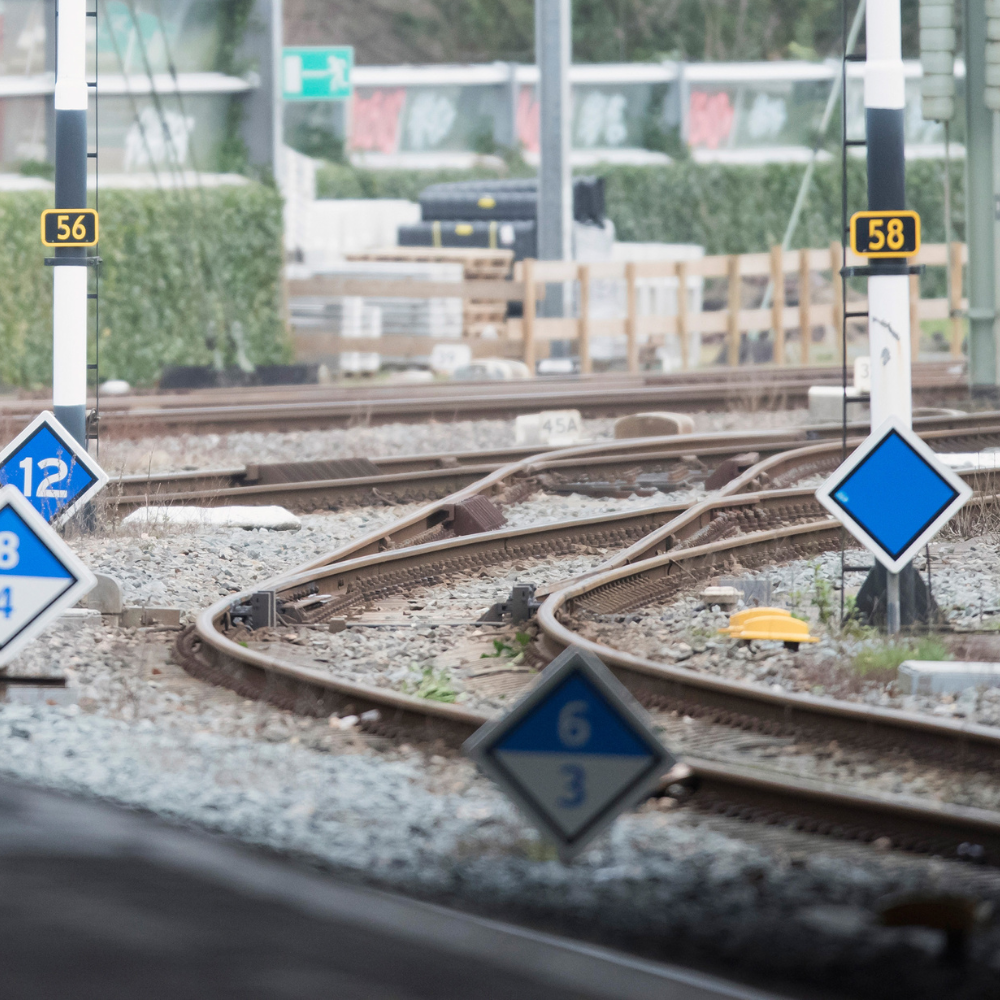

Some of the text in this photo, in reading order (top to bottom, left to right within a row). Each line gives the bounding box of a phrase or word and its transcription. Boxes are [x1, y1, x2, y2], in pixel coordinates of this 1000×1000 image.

[56, 214, 87, 241] 56
[868, 217, 905, 251] 58
[542, 416, 578, 434] 45A
[19, 456, 69, 499] 12
[557, 699, 592, 749] 6
[556, 762, 587, 811] 3
